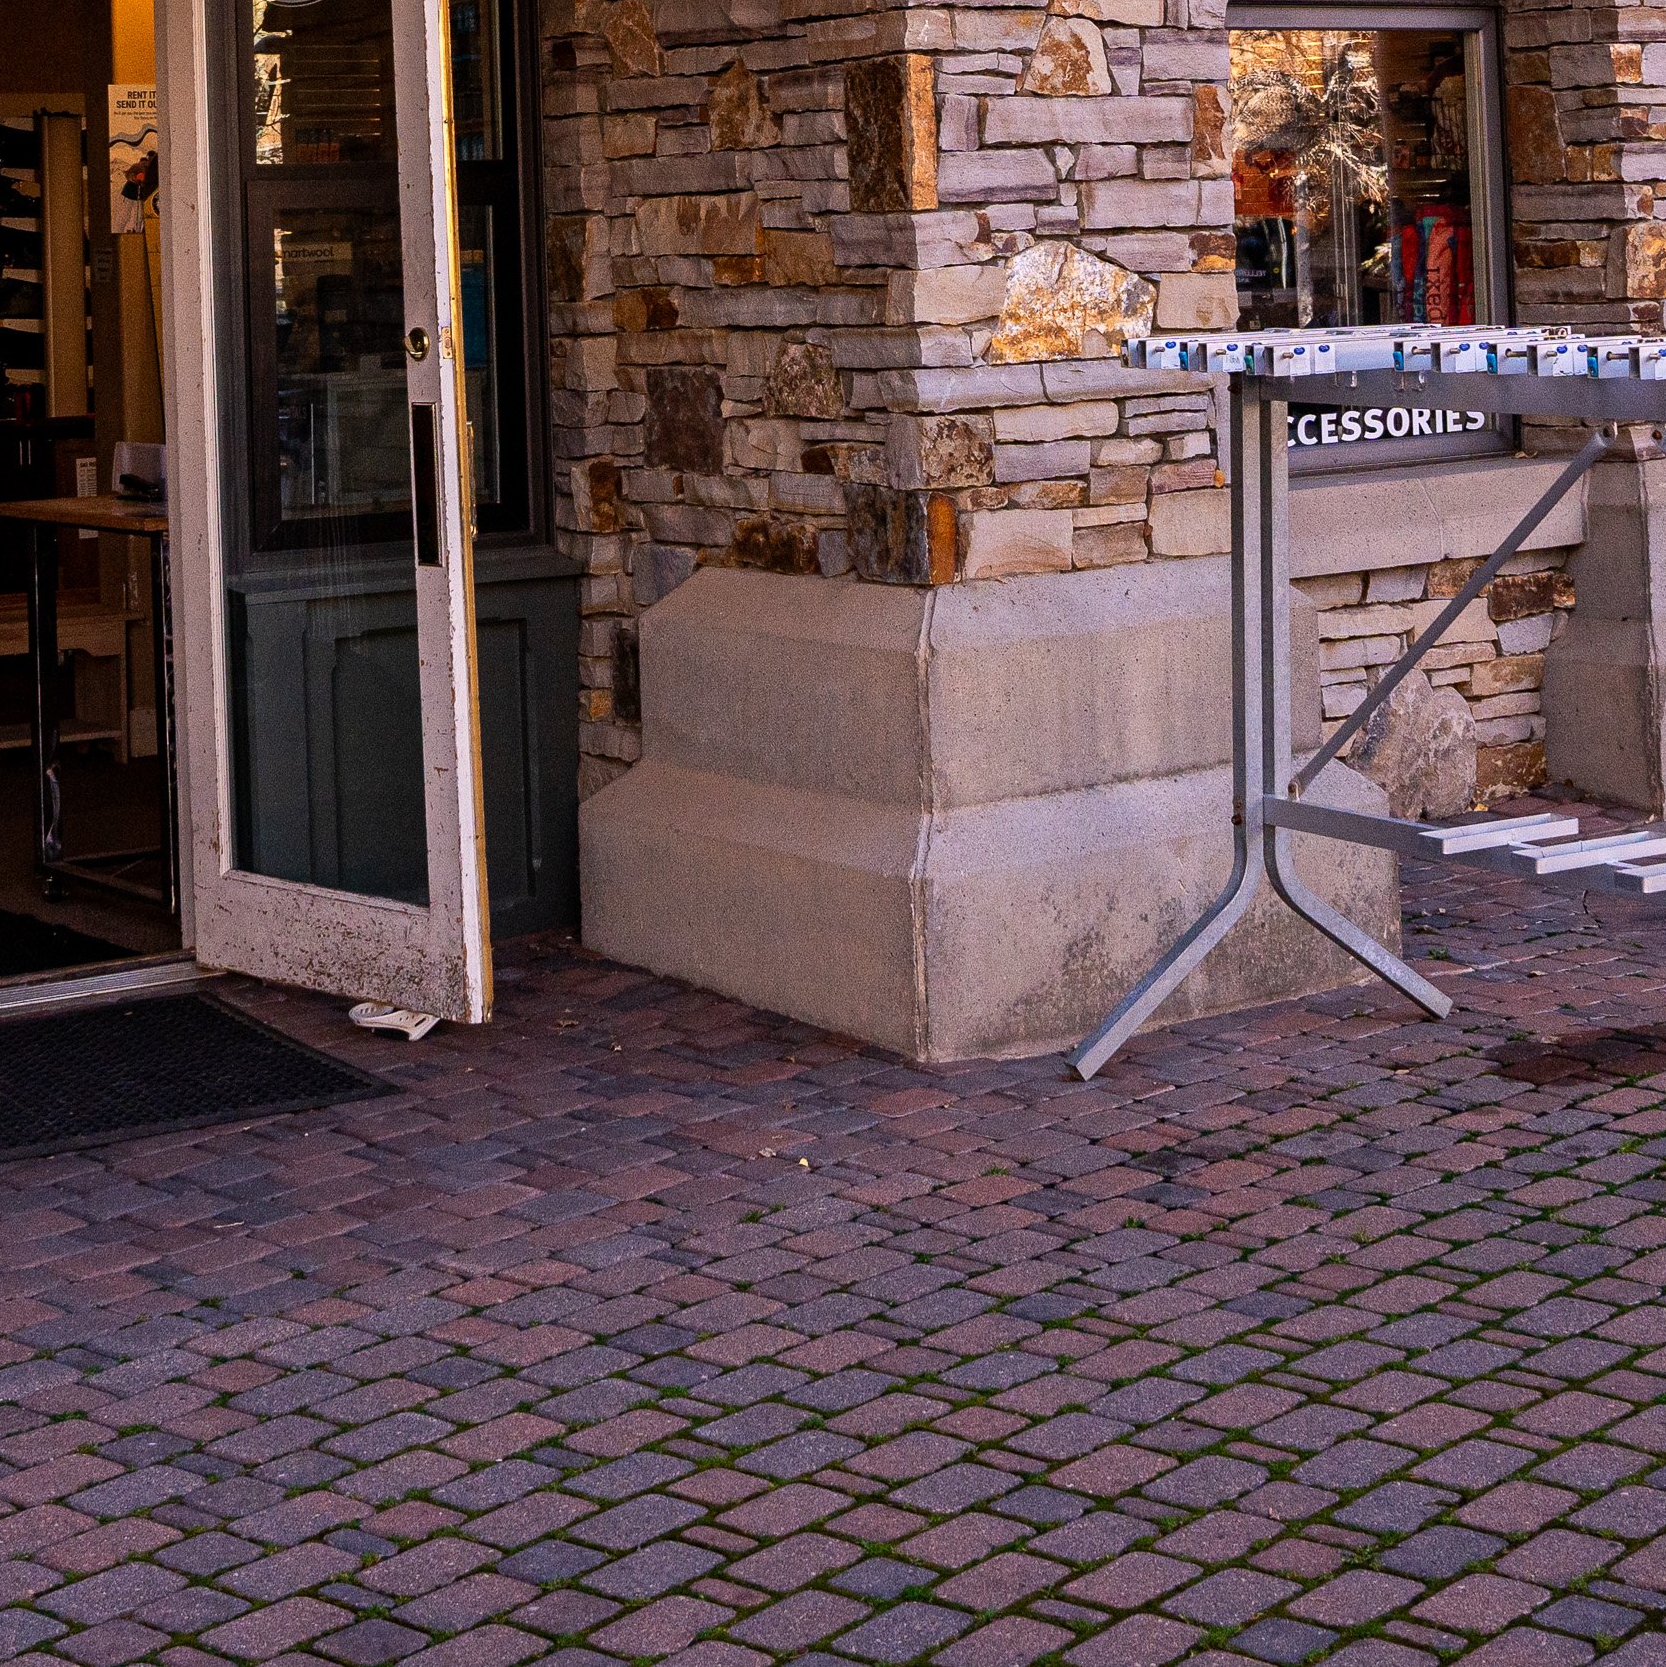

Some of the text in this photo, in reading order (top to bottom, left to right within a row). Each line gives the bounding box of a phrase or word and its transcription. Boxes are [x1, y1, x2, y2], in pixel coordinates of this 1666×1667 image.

[127, 91, 156, 99] RENT IT
[116, 100, 157, 108] SEND IT OU
[1287, 407, 1485, 447] CCESSORIES
